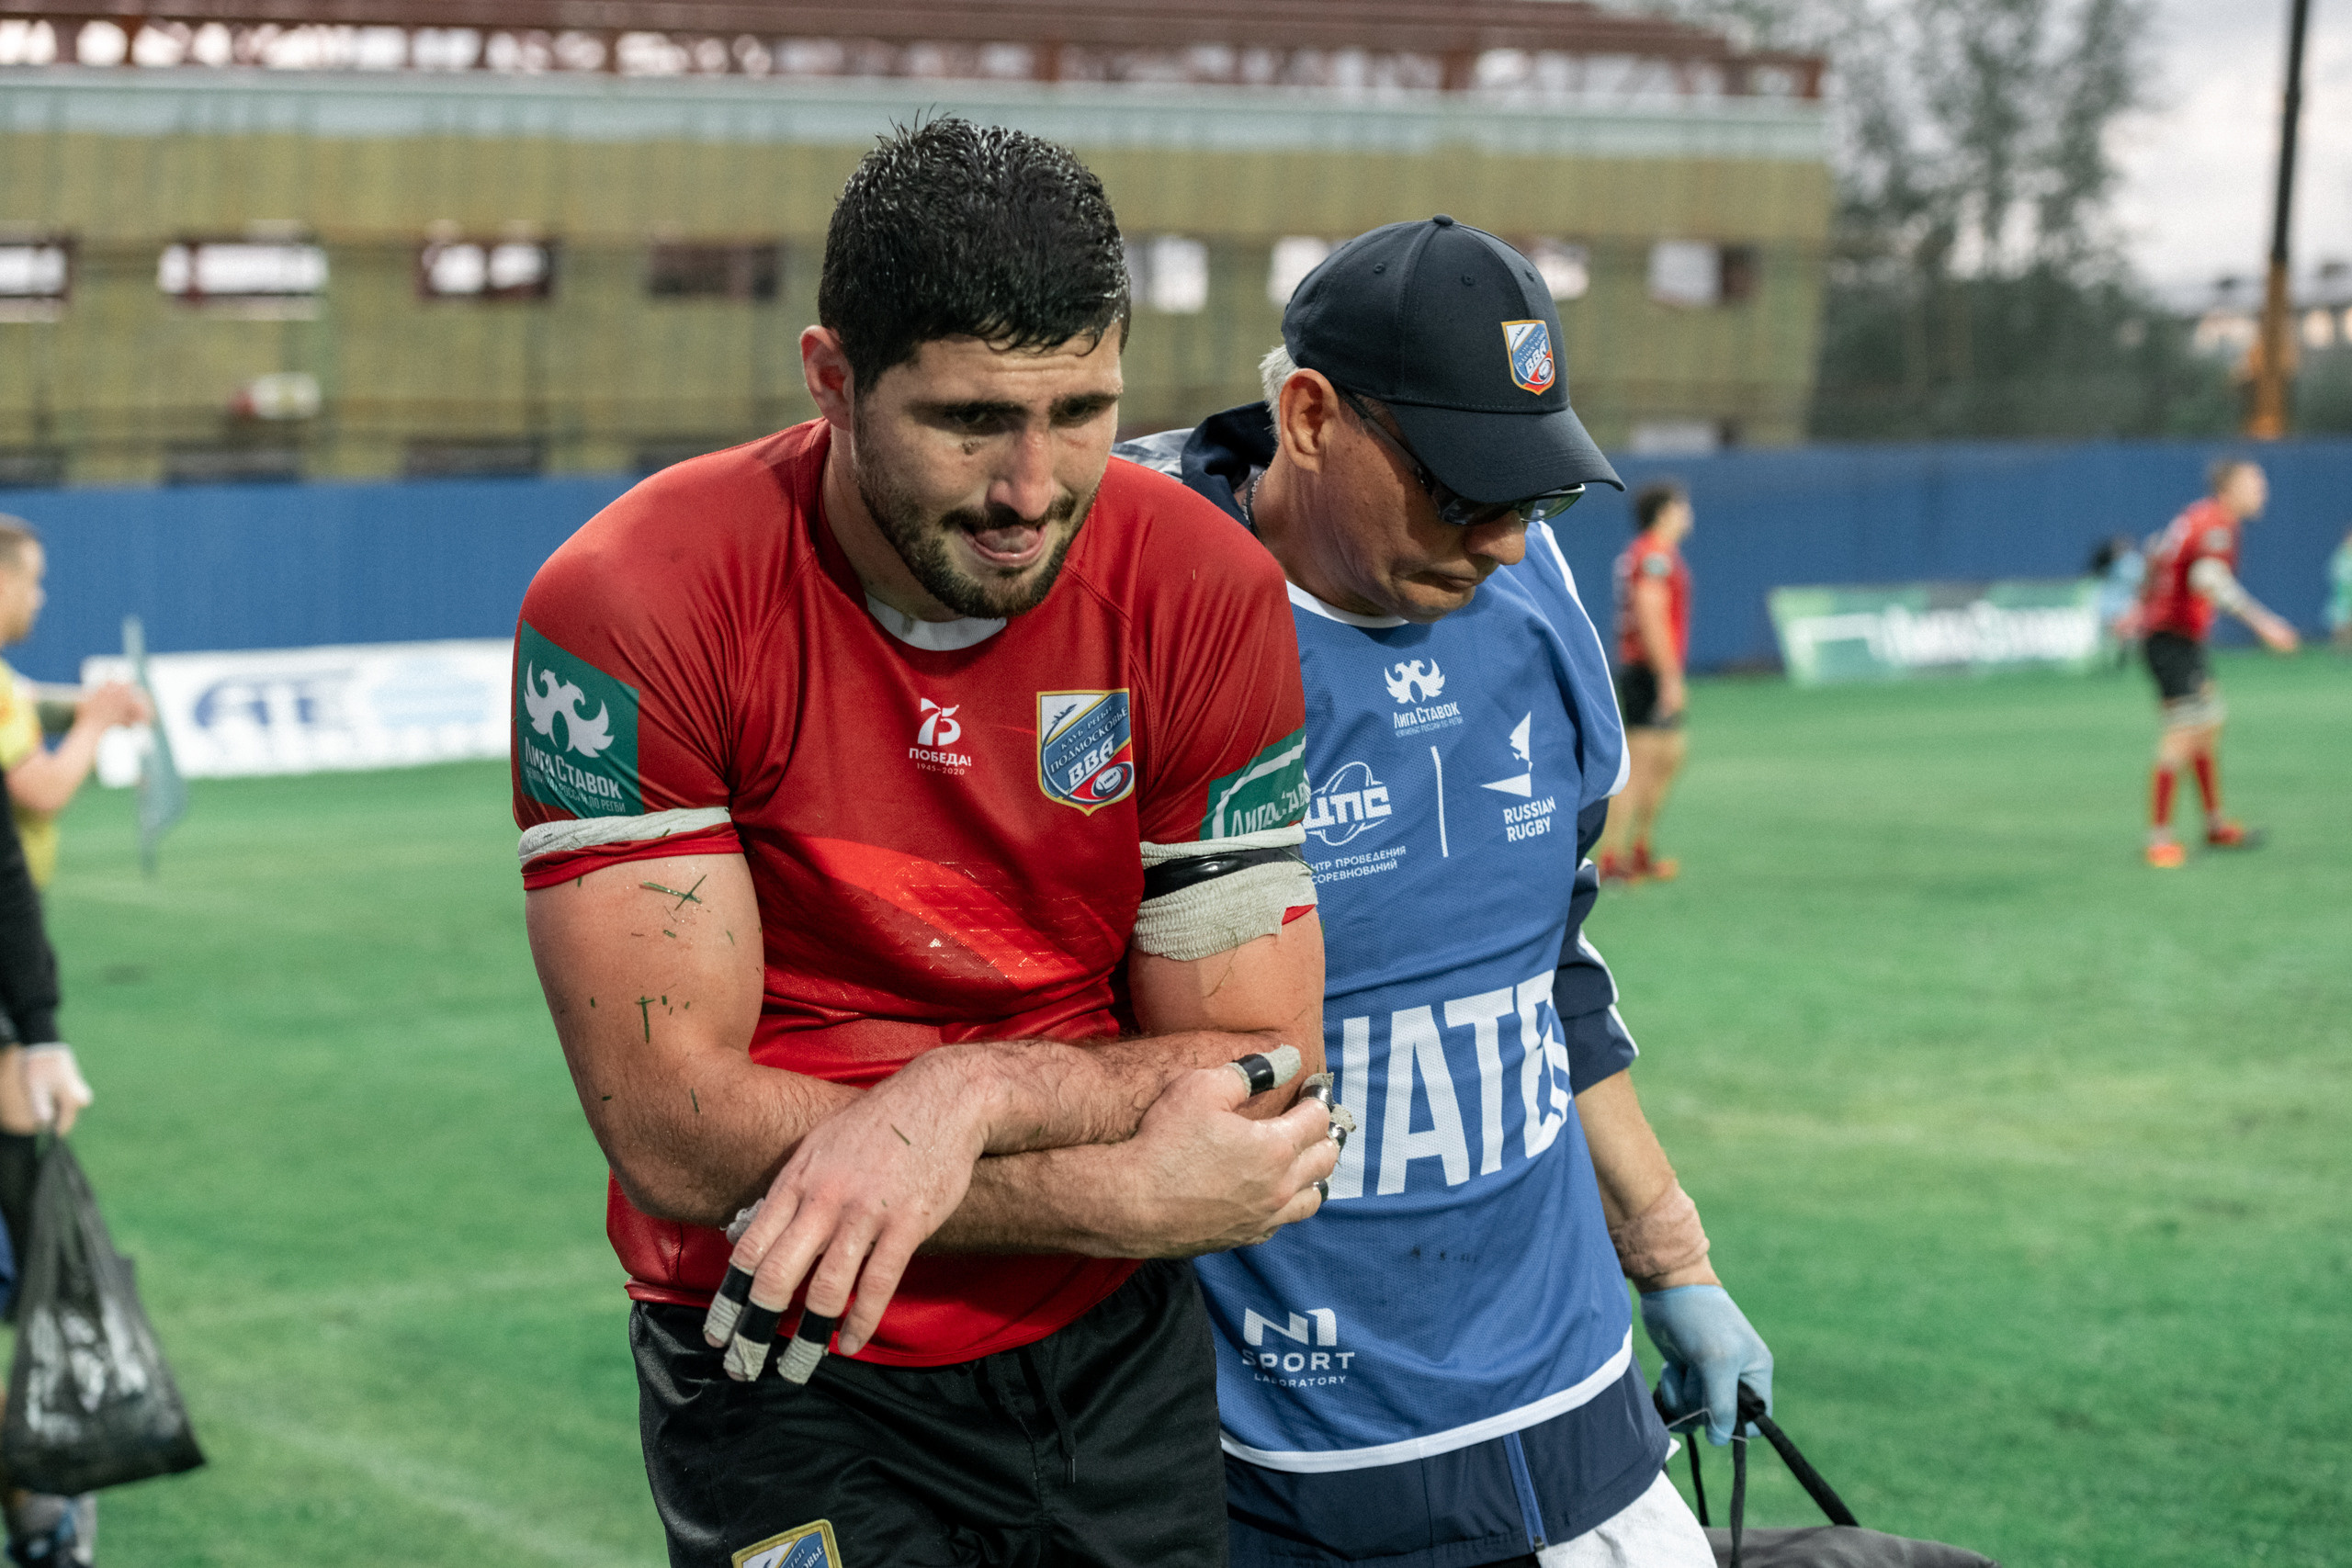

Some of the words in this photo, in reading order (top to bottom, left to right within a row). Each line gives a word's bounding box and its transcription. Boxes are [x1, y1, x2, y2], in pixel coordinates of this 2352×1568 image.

[909, 747, 972, 767] ПОБЕДА!
[1068, 733, 1115, 788] ВВА
[1503, 795, 1556, 825] RUSSIAN
[1506, 816, 1551, 842] RUGBY
[1311, 860, 1331, 872] НТР
[1335, 846, 1406, 868] ПРОВЕДЕНИЯ
[1311, 858, 1398, 885] СОРЕВНОВАНИЙ
[1242, 1349, 1355, 1372] SPORT
